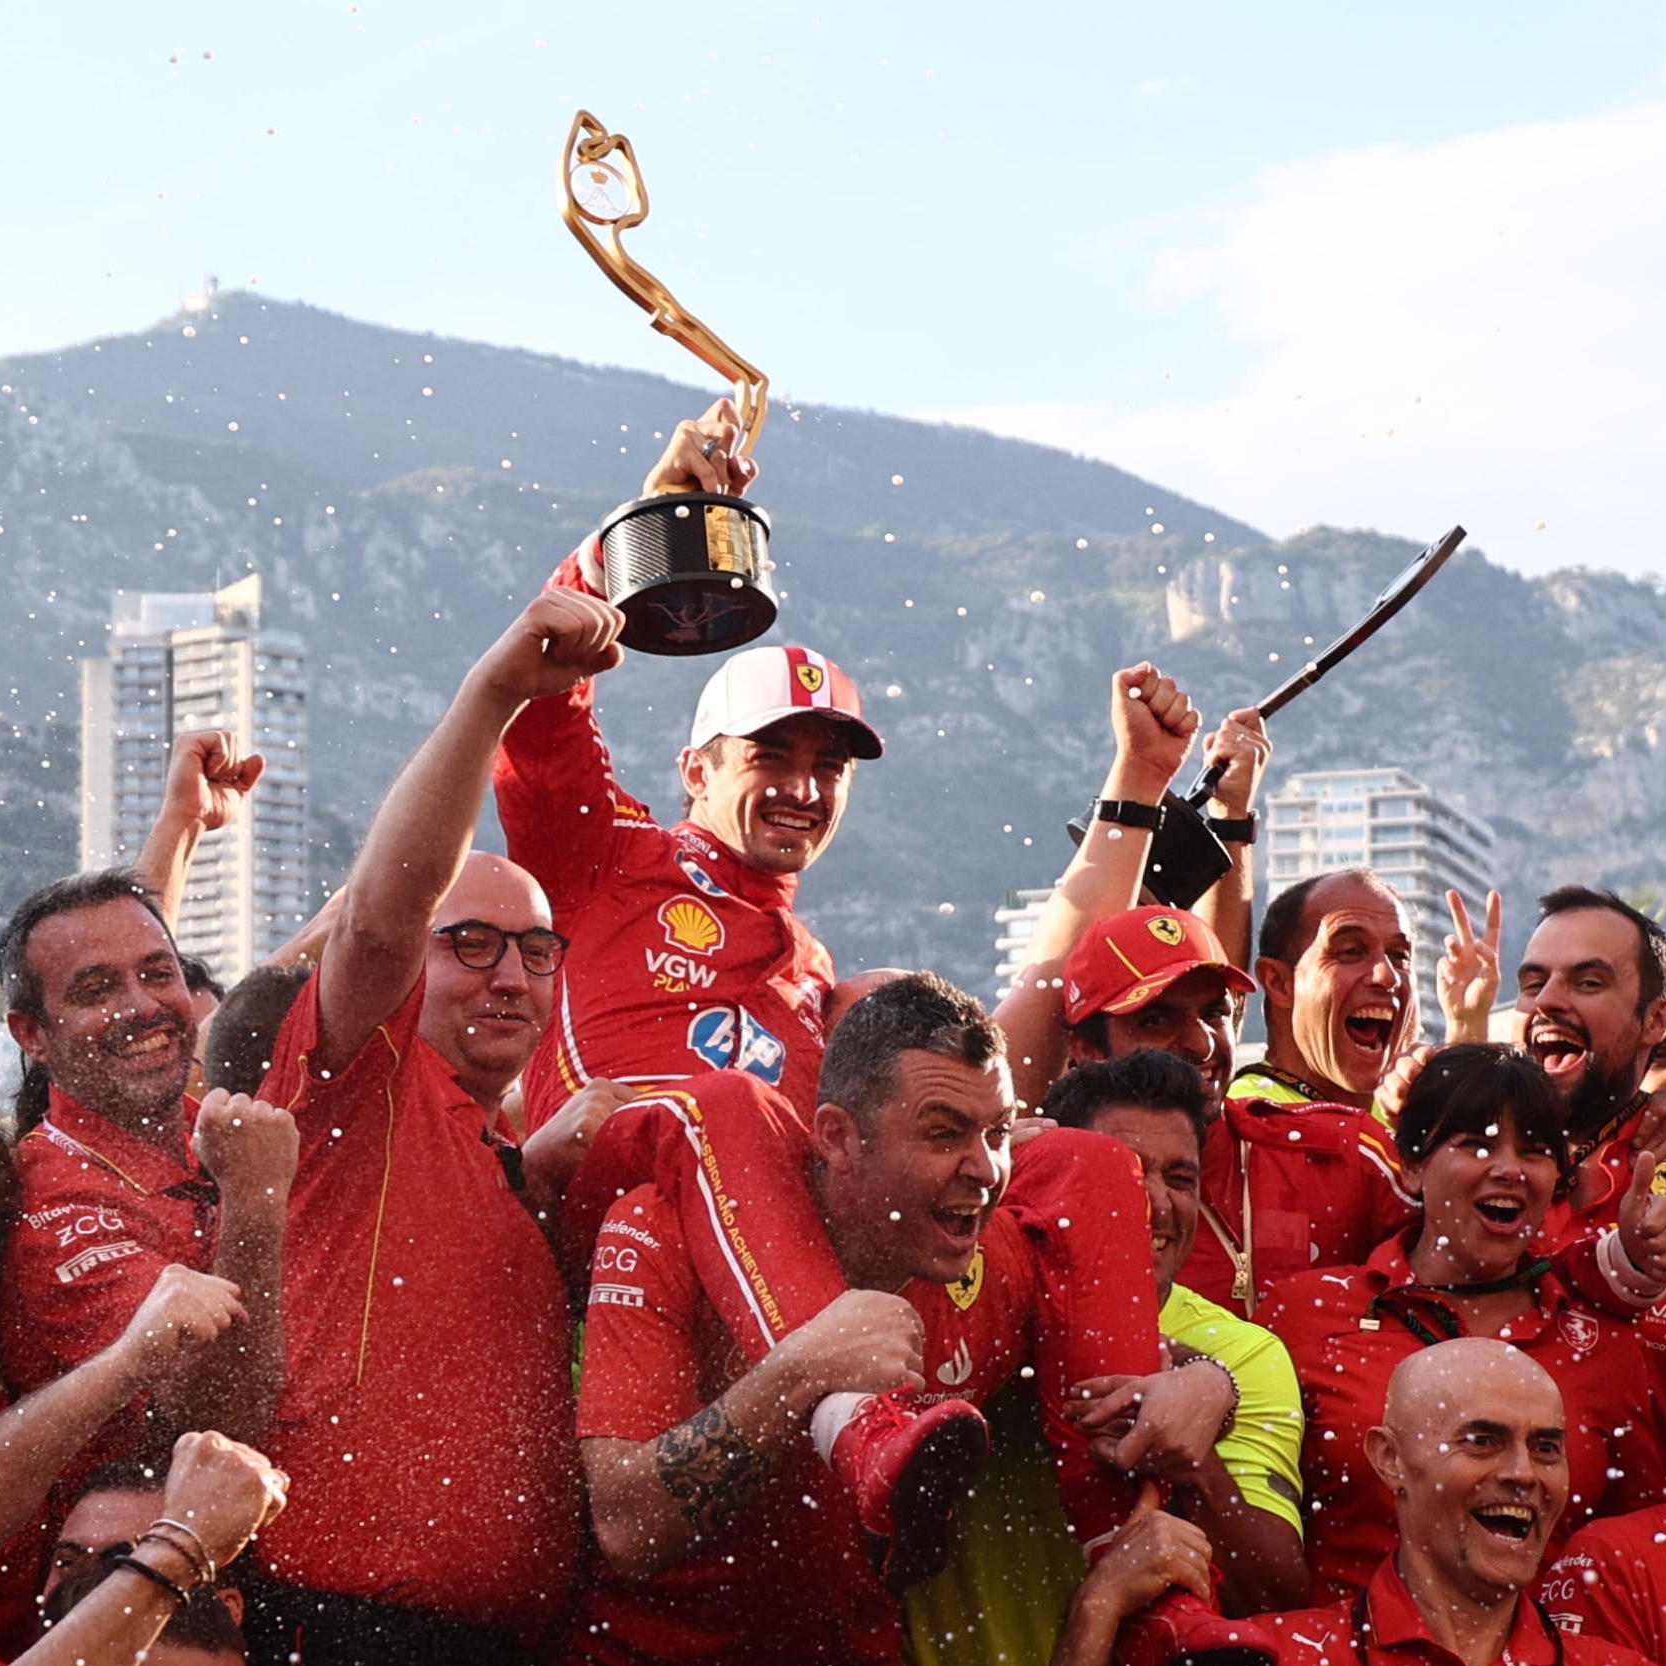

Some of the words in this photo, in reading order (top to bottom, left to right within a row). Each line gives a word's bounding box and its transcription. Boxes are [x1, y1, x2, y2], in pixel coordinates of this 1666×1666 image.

[645, 947, 718, 989] VGW
[652, 973, 691, 994] PLA
[54, 1214, 126, 1248] ZCG
[54, 1240, 145, 1284] PIRELLI
[728, 1227, 785, 1331] ACHIEVEMENT
